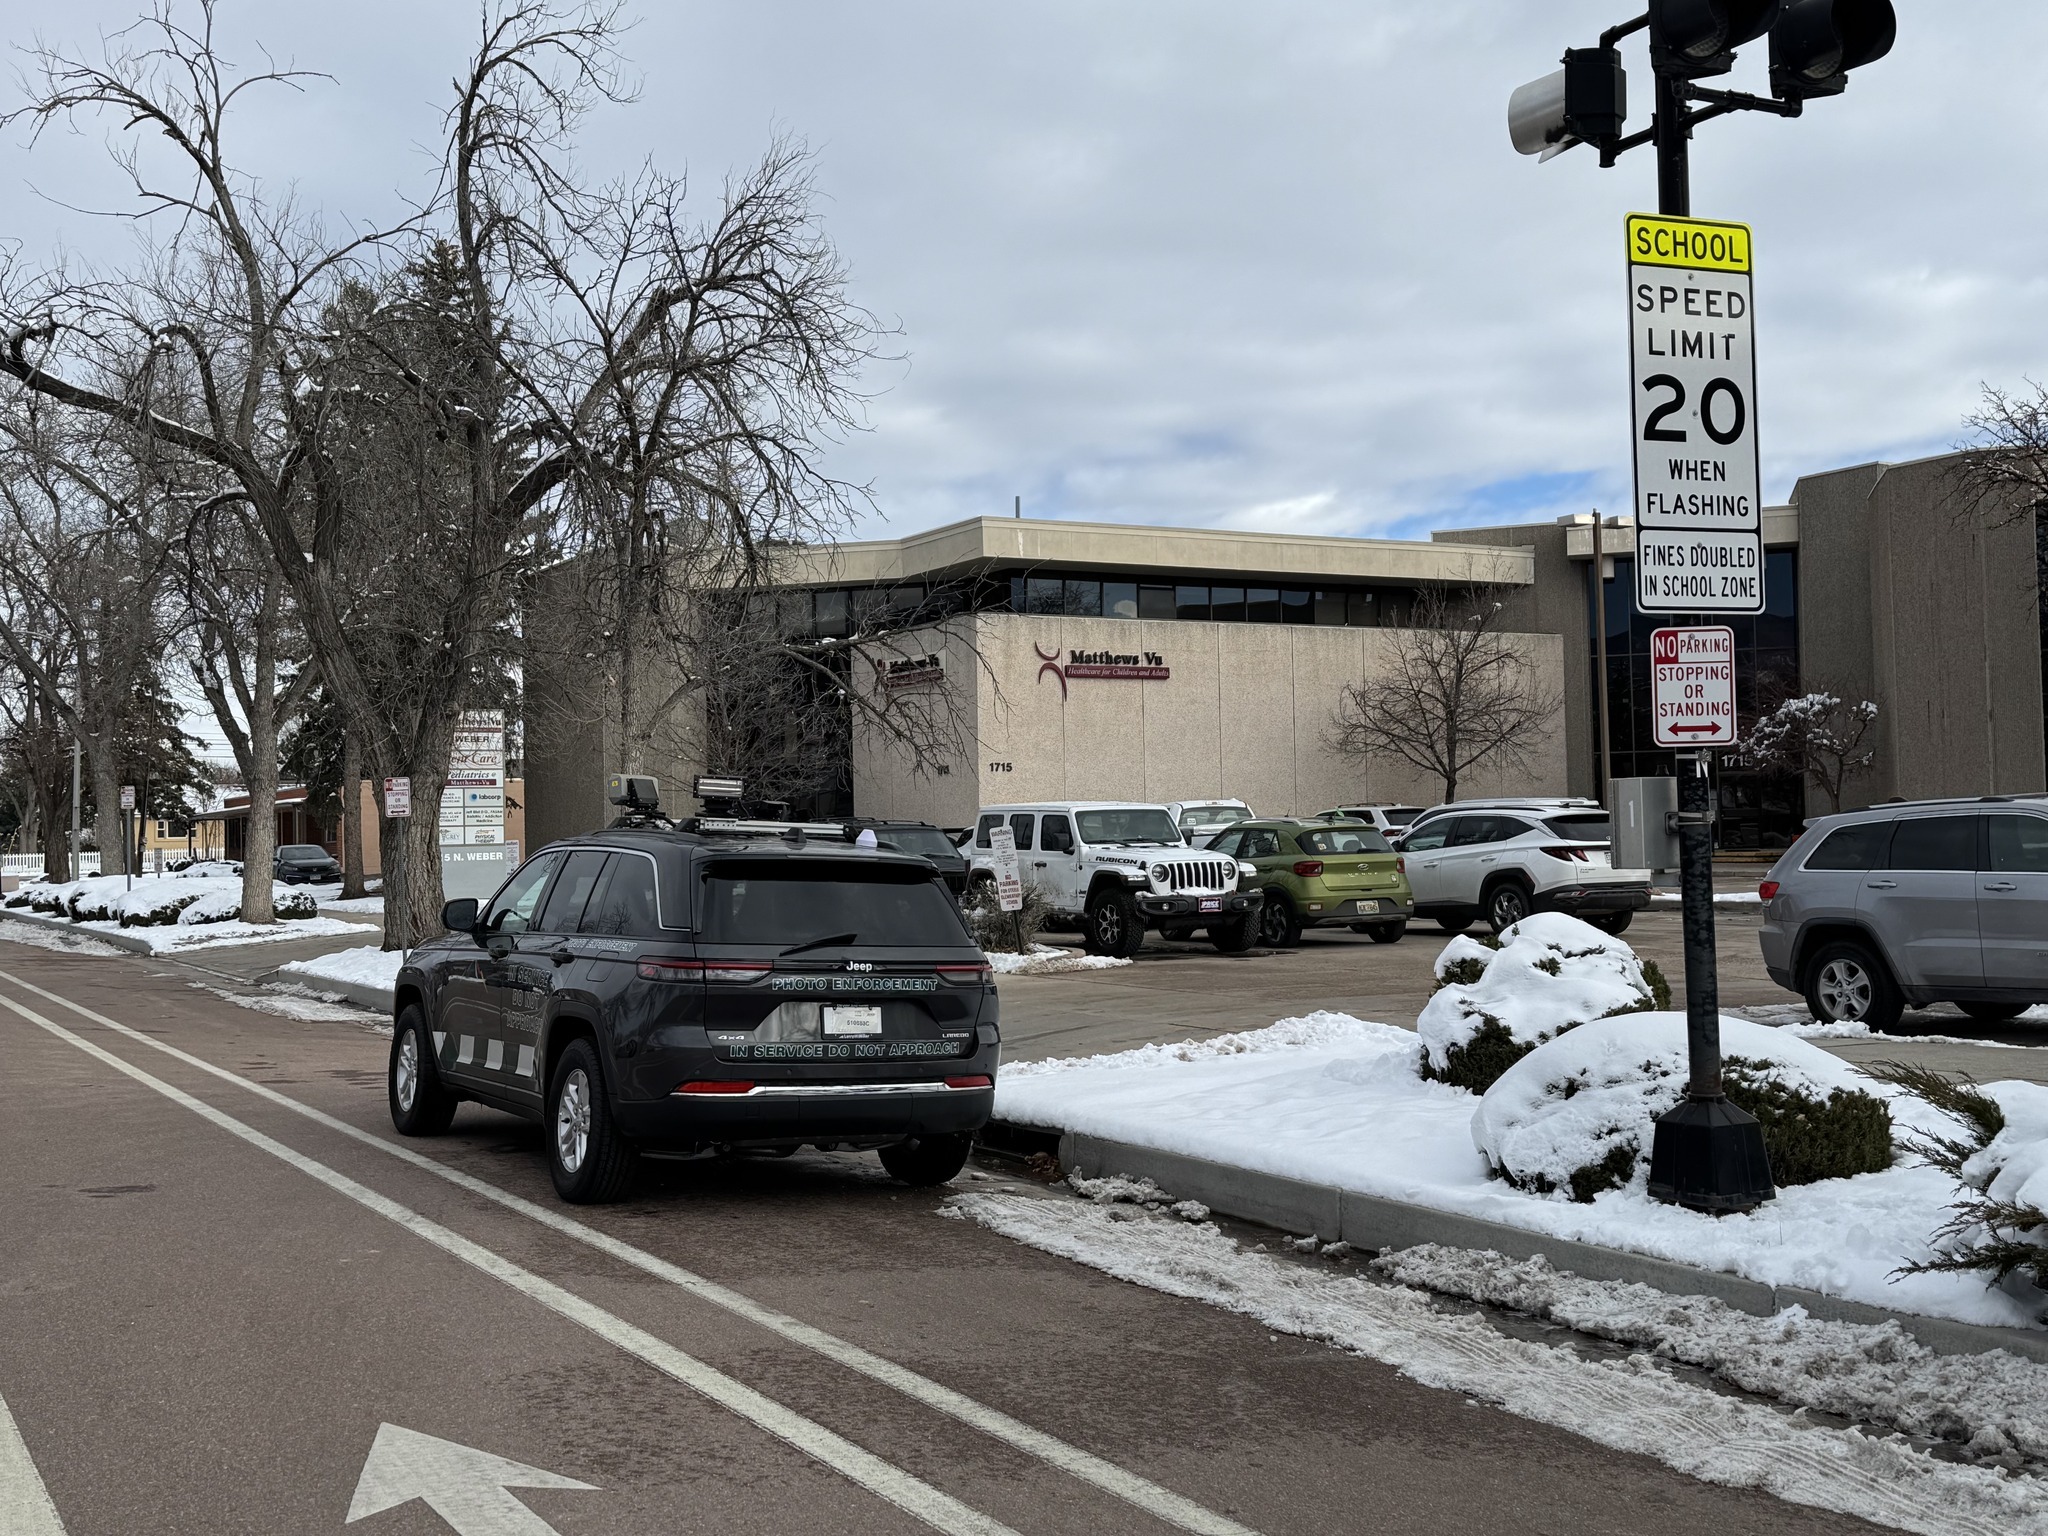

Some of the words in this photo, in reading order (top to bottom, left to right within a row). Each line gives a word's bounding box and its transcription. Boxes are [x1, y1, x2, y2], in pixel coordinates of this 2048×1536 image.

[1636, 227, 1743, 263] SCHOOL
[1636, 284, 1746, 319] SPEED
[1648, 328, 1736, 360] LIMIT
[1642, 373, 1746, 445] 20
[1669, 459, 1726, 482] WHEN
[1647, 493, 1749, 517] FLASHING
[1644, 545, 1685, 567] FINES
[1690, 546, 1755, 568] DOUBLED
[1645, 575, 1657, 596] IN
[1663, 575, 1716, 597] SCHOOL
[1721, 576, 1756, 598] ZONE
[1655, 636, 1677, 657] NO
[1680, 638, 1728, 653] PARKING
[1070, 650, 1139, 665] Matthews
[1144, 652, 1163, 666] Vu
[1068, 667, 1101, 675] Healthcare
[1101, 668, 1111, 676] for
[1112, 668, 1138, 676] Children
[1658, 666, 1729, 682] STOPPING
[1684, 685, 1704, 698] OR
[1659, 702, 1730, 717] STANDING
[455, 735, 490, 743] WEBER
[472, 753, 498, 764] Care
[1721, 754, 1753, 767] 1715
[989, 762, 1013, 772] 1715
[454, 853, 464, 861] N.
[467, 852, 503, 860] WEBER
[1095, 856, 1137, 865] RUBICON
[846, 961, 873, 972] Jeep
[772, 978, 827, 990] PHOTO
[832, 978, 937, 990] ENFORCEMENT
[730, 1045, 749, 1057] IN
[754, 1045, 824, 1057] SERVICE
[829, 1045, 851, 1057] DO
[855, 1044, 885, 1057] NOT
[889, 1042, 959, 1055] APPROACH
